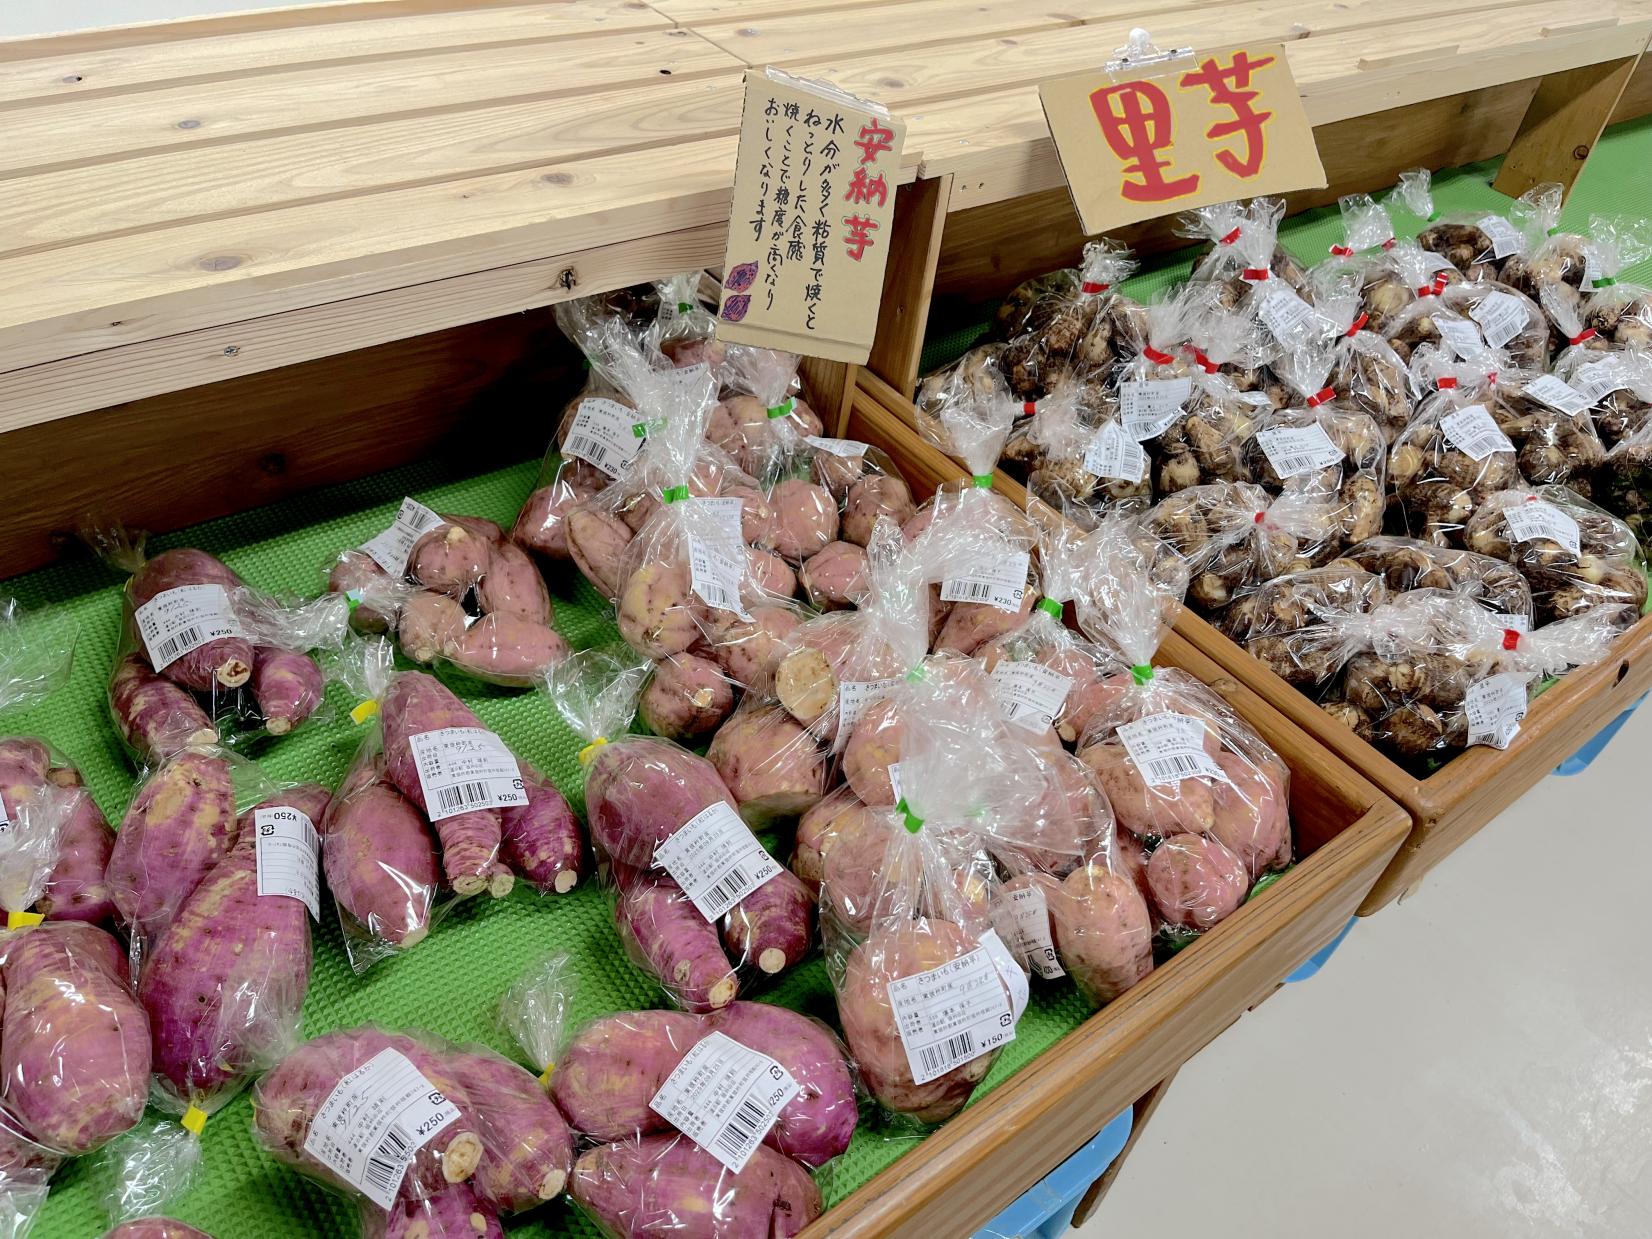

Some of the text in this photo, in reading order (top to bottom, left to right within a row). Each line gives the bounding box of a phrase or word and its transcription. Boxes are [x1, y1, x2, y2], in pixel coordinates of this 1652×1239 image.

[1088, 51, 1276, 202] 里芋
[749, 98, 779, 242] おいしくなります
[786, 109, 822, 262] ねっとりした食感
[841, 117, 897, 262] 安納芋
[498, 793, 518, 801] ¥250
[274, 812, 297, 822] ¥250
[754, 865, 773, 880] ¥250
[981, 1033, 1003, 1048] ¥150
[416, 1112, 445, 1136] ¥250
